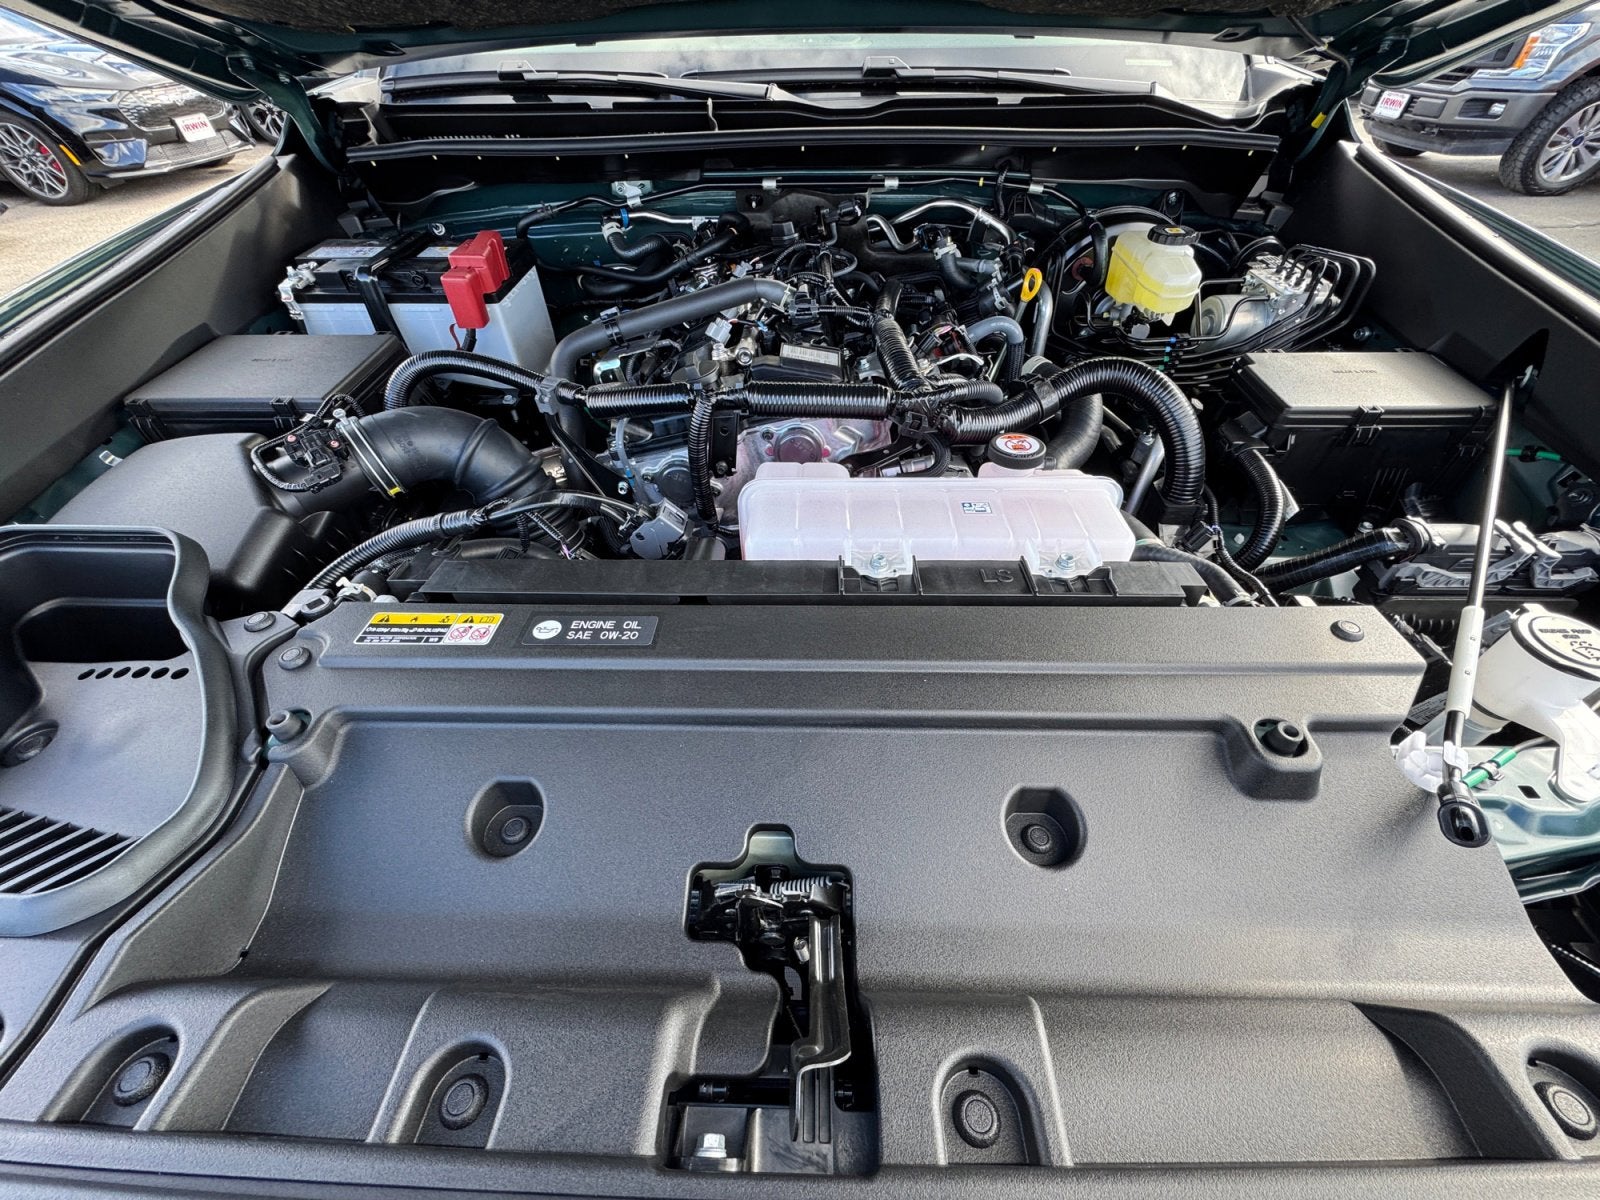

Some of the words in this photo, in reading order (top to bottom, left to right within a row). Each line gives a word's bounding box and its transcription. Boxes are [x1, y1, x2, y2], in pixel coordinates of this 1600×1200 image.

[1381, 97, 1404, 109] IRWIN
[182, 120, 209, 132] IRWIN
[980, 568, 1014, 583] LS
[570, 620, 616, 629] ENGINE
[623, 620, 642, 629] OIL
[566, 631, 593, 640] SAE
[599, 631, 639, 640] 0W-20
